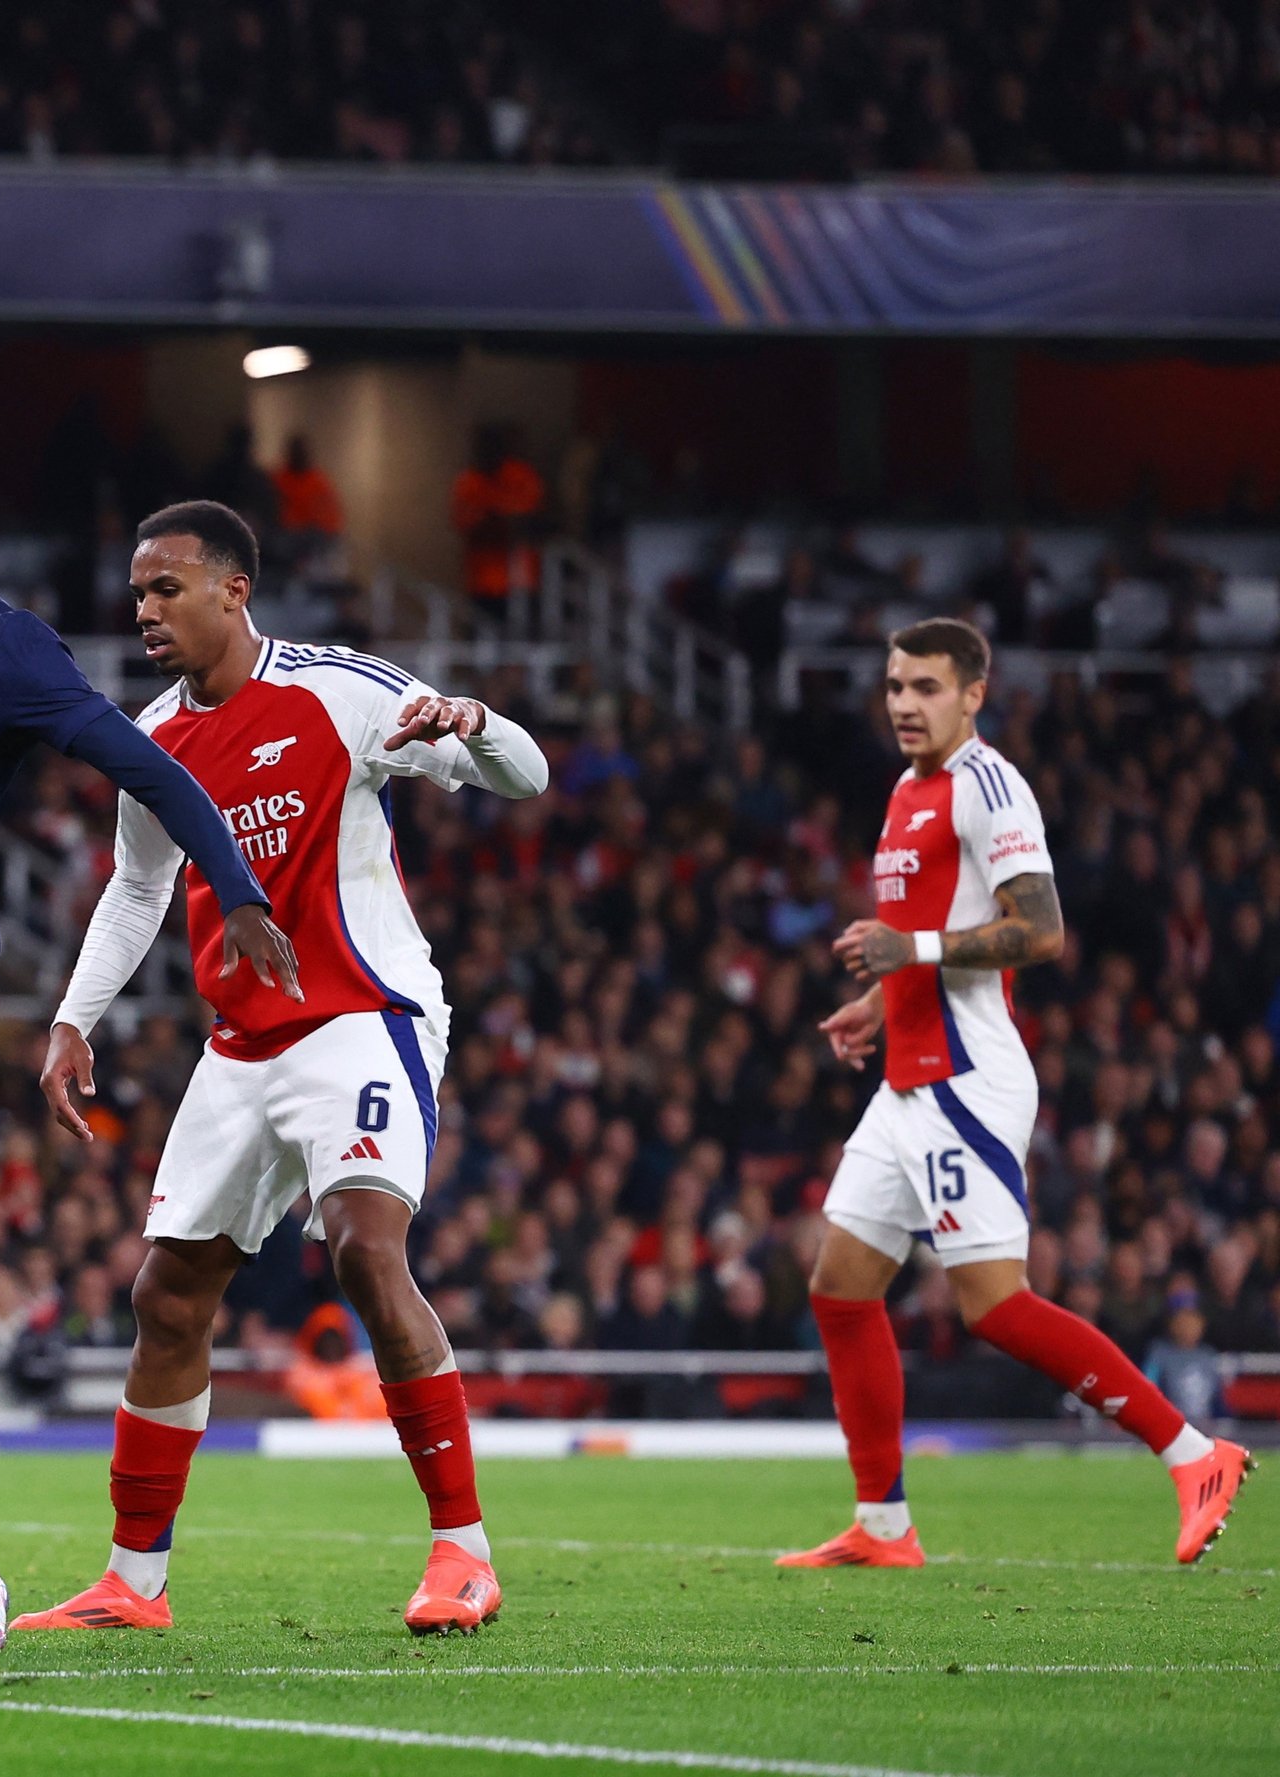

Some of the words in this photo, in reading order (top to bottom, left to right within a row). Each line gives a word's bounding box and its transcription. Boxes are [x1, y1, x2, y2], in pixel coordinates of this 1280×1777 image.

[214, 789, 306, 835] rates
[356, 1081, 391, 1132] 6
[925, 1148, 967, 1203] 15
